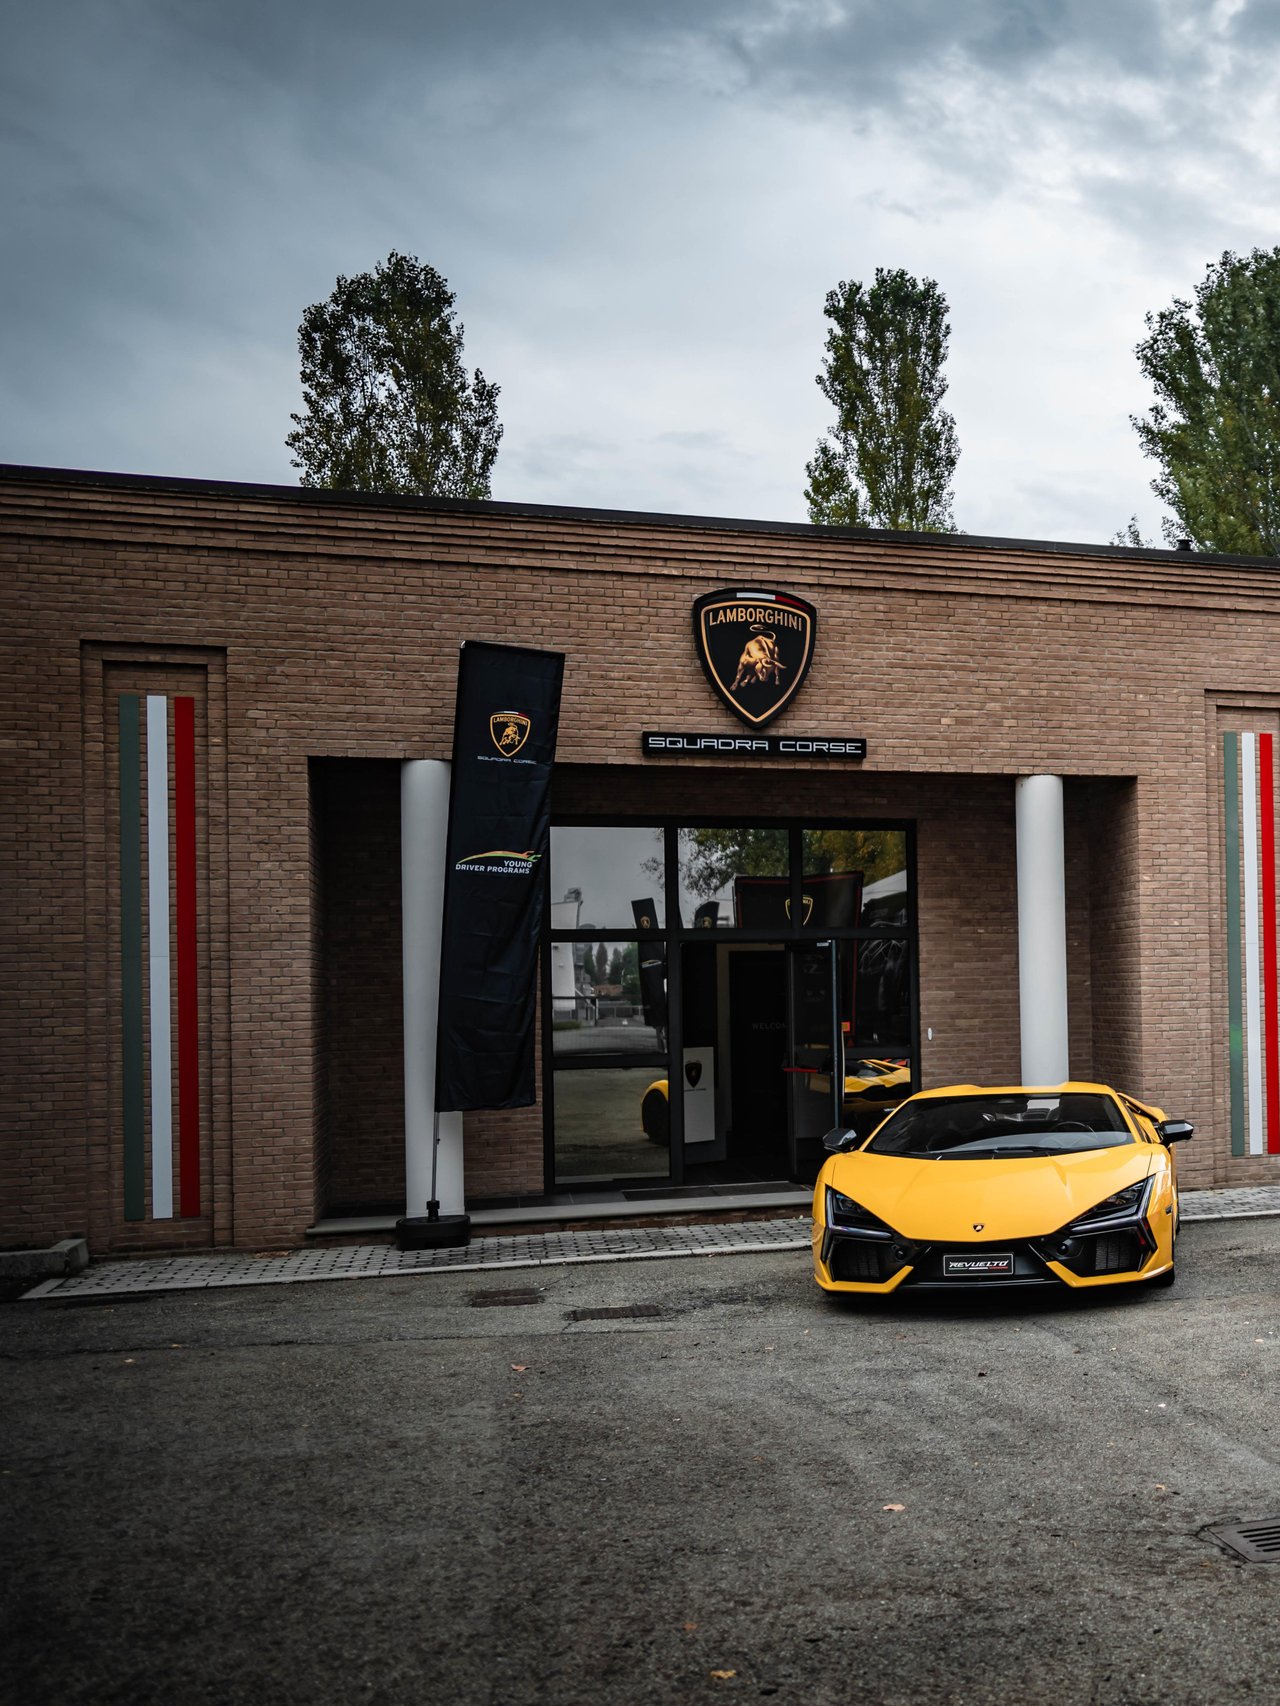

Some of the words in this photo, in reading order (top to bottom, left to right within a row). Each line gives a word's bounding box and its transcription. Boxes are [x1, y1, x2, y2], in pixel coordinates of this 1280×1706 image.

[709, 607, 802, 632] LAMBORGHINI
[648, 737, 769, 750] SQUADRA
[779, 741, 862, 753] CORSE
[455, 863, 485, 872] DRIVER
[487, 866, 530, 874] PROGRAMS
[504, 860, 533, 868] YOUNG
[949, 1260, 1009, 1268] REVUELTO
